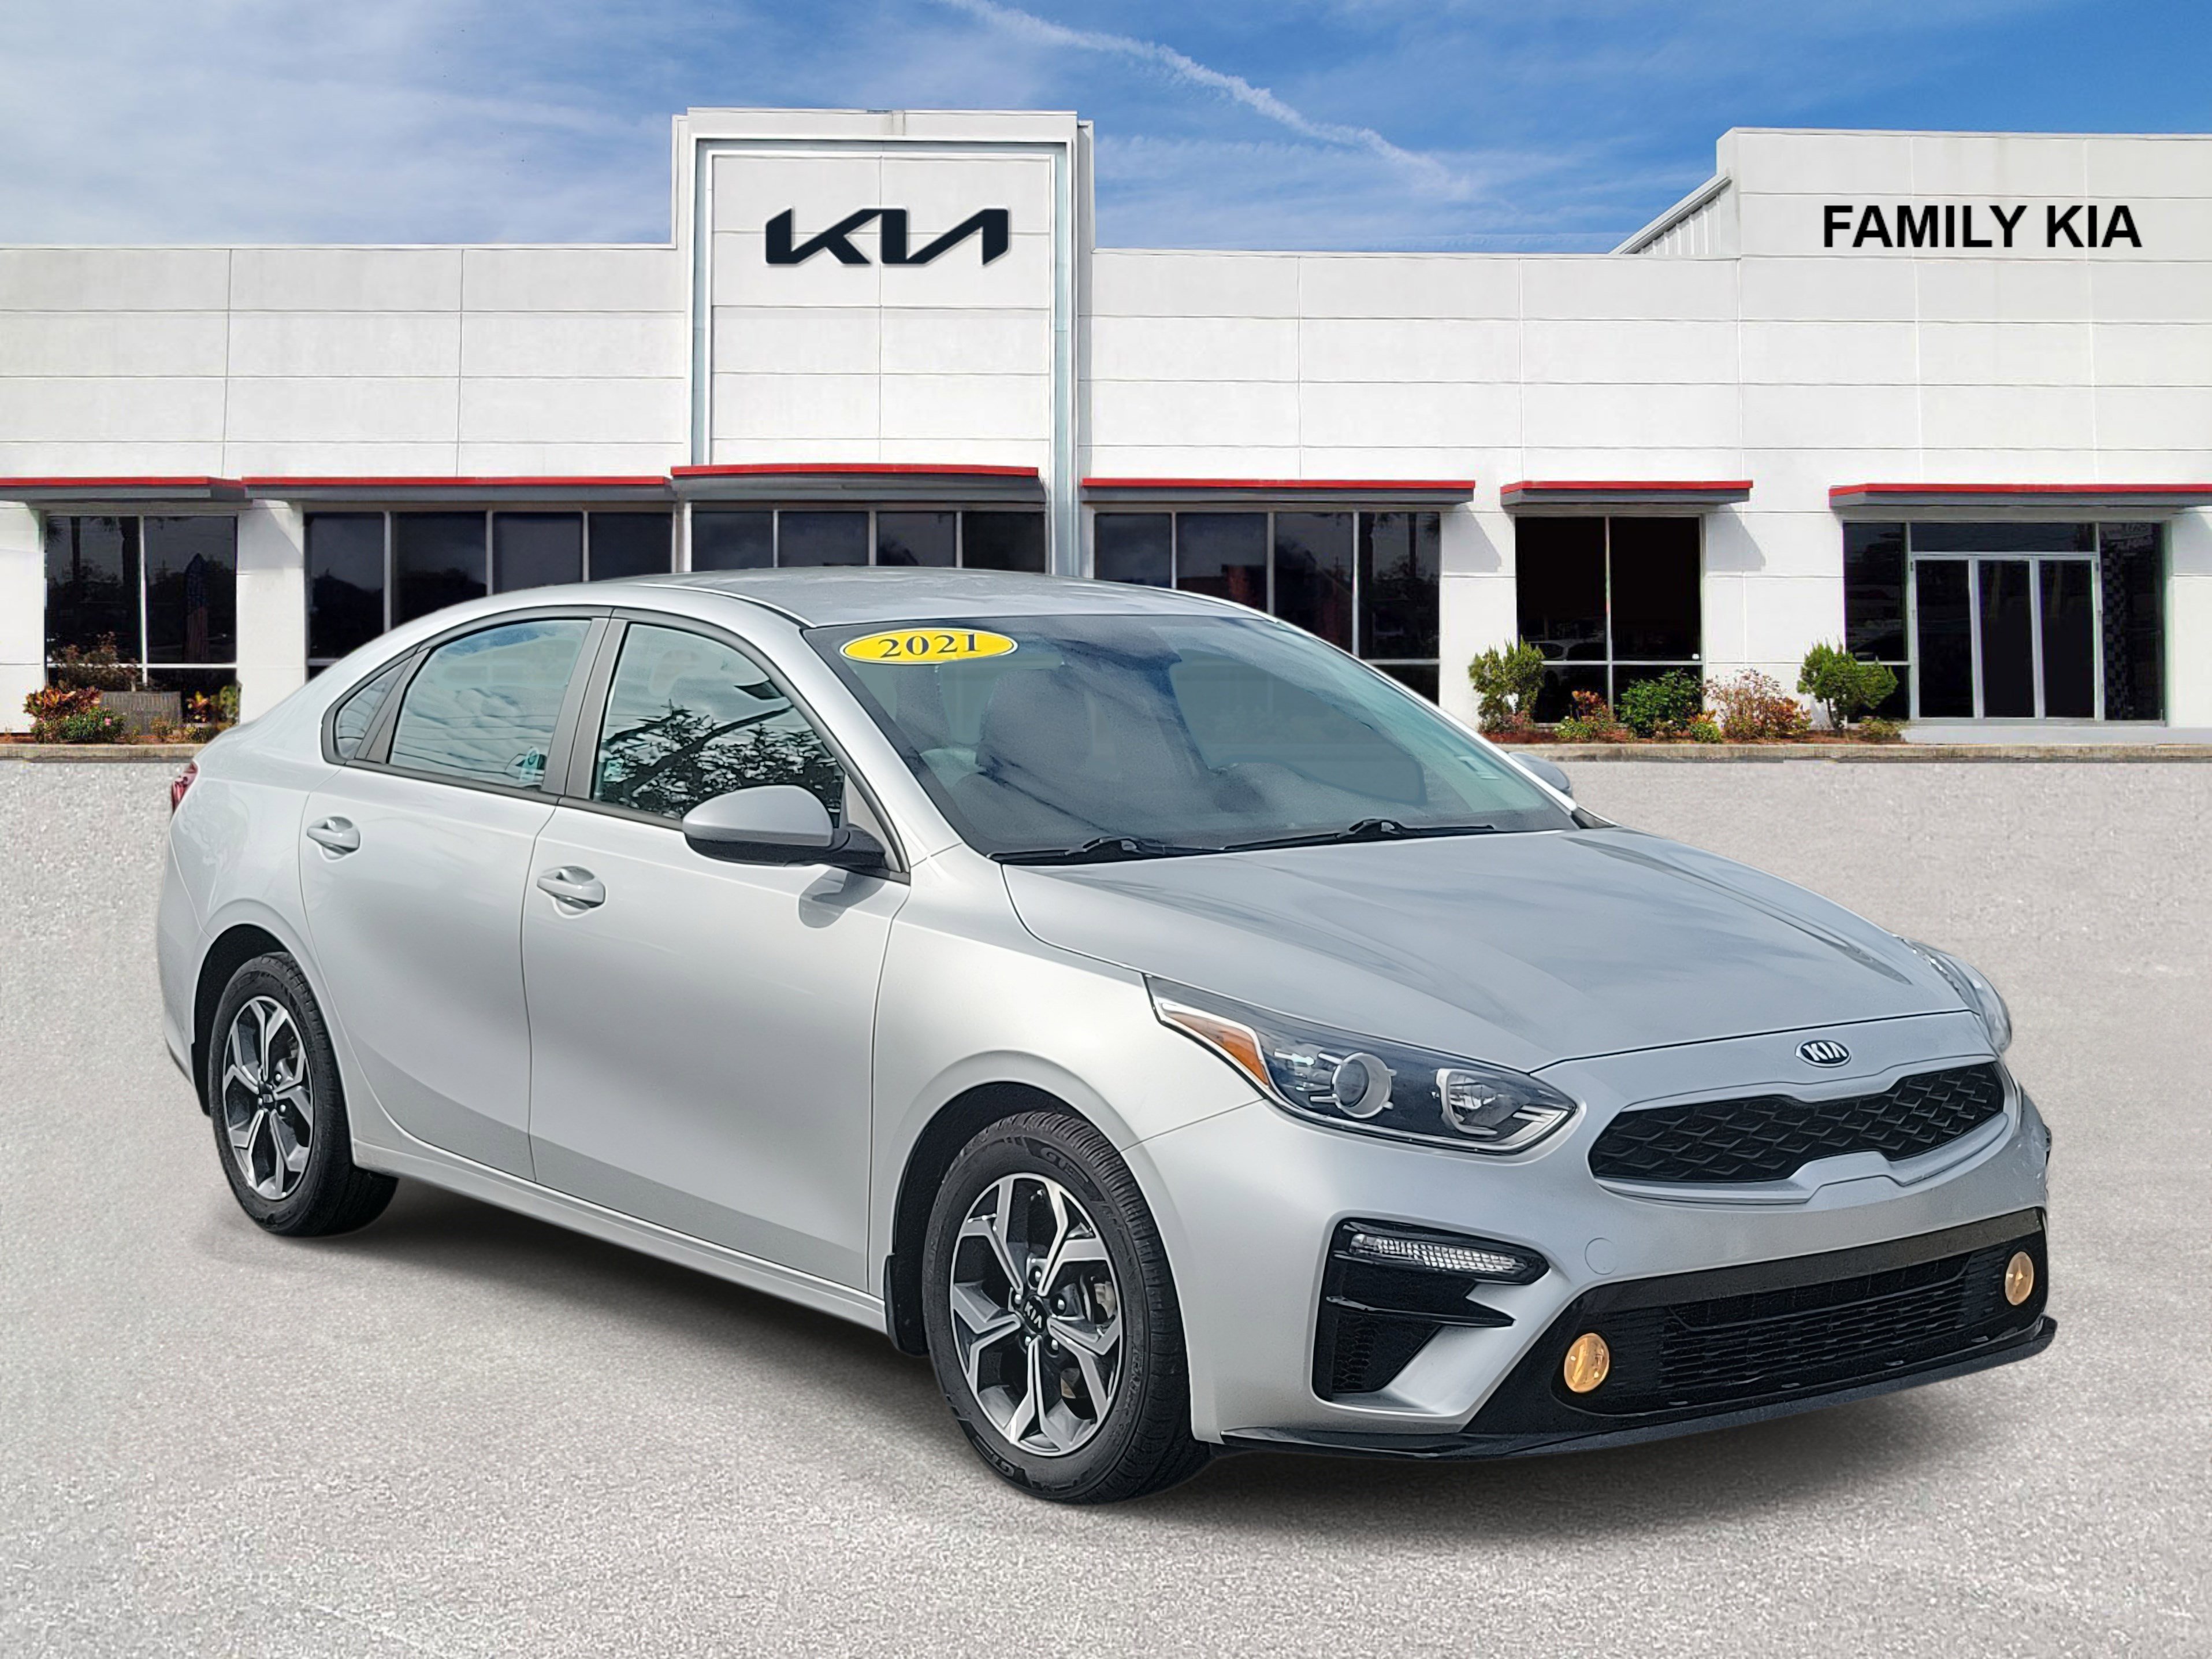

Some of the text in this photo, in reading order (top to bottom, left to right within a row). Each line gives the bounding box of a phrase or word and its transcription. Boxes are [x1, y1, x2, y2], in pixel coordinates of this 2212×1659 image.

[1823, 205, 2143, 248] FAMILY KIA
[878, 633, 982, 659] 2021
[1802, 1041, 1848, 1062] KIA
[1024, 1300, 1042, 1329] KIA
